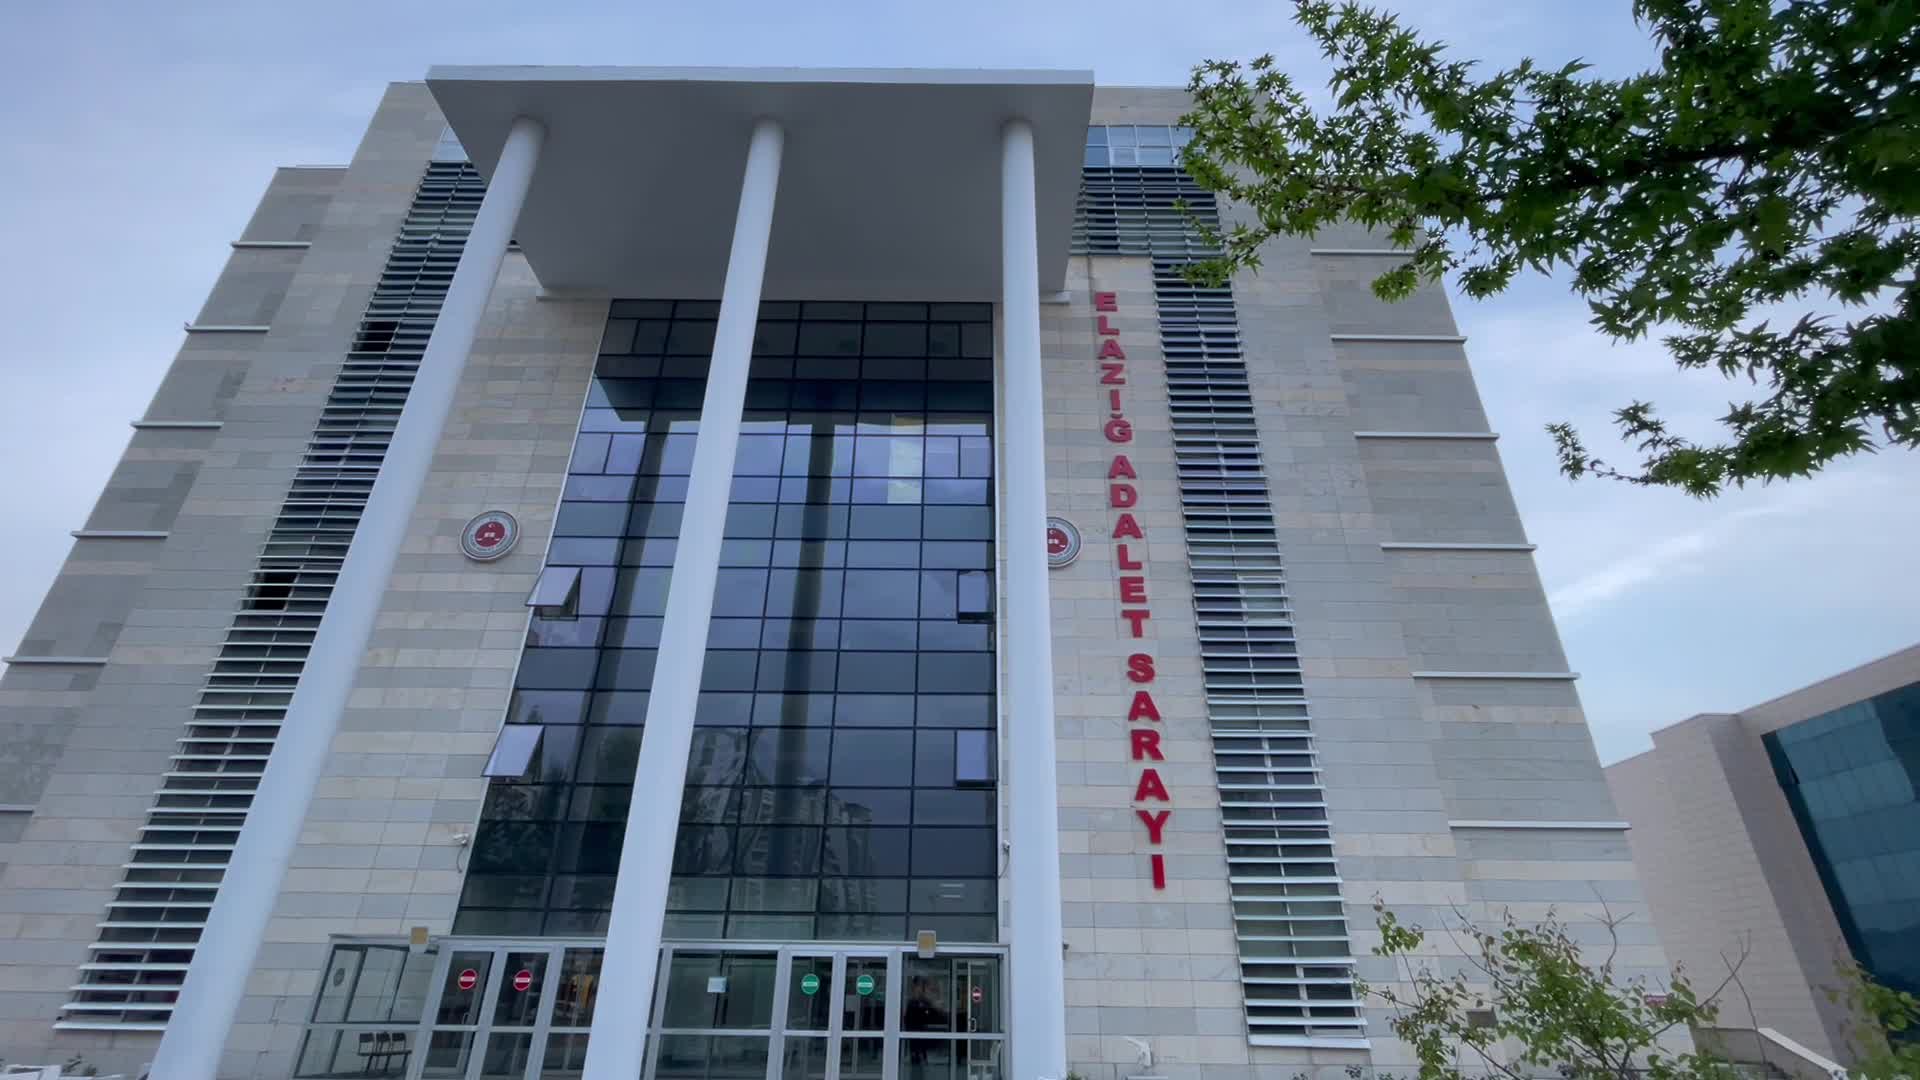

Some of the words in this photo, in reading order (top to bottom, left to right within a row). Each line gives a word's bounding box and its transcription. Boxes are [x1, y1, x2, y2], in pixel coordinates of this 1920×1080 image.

[1094, 291, 1133, 443] ELAZIĞ
[1108, 455, 1150, 638] ADALET
[1126, 653, 1171, 890] SARAYI
